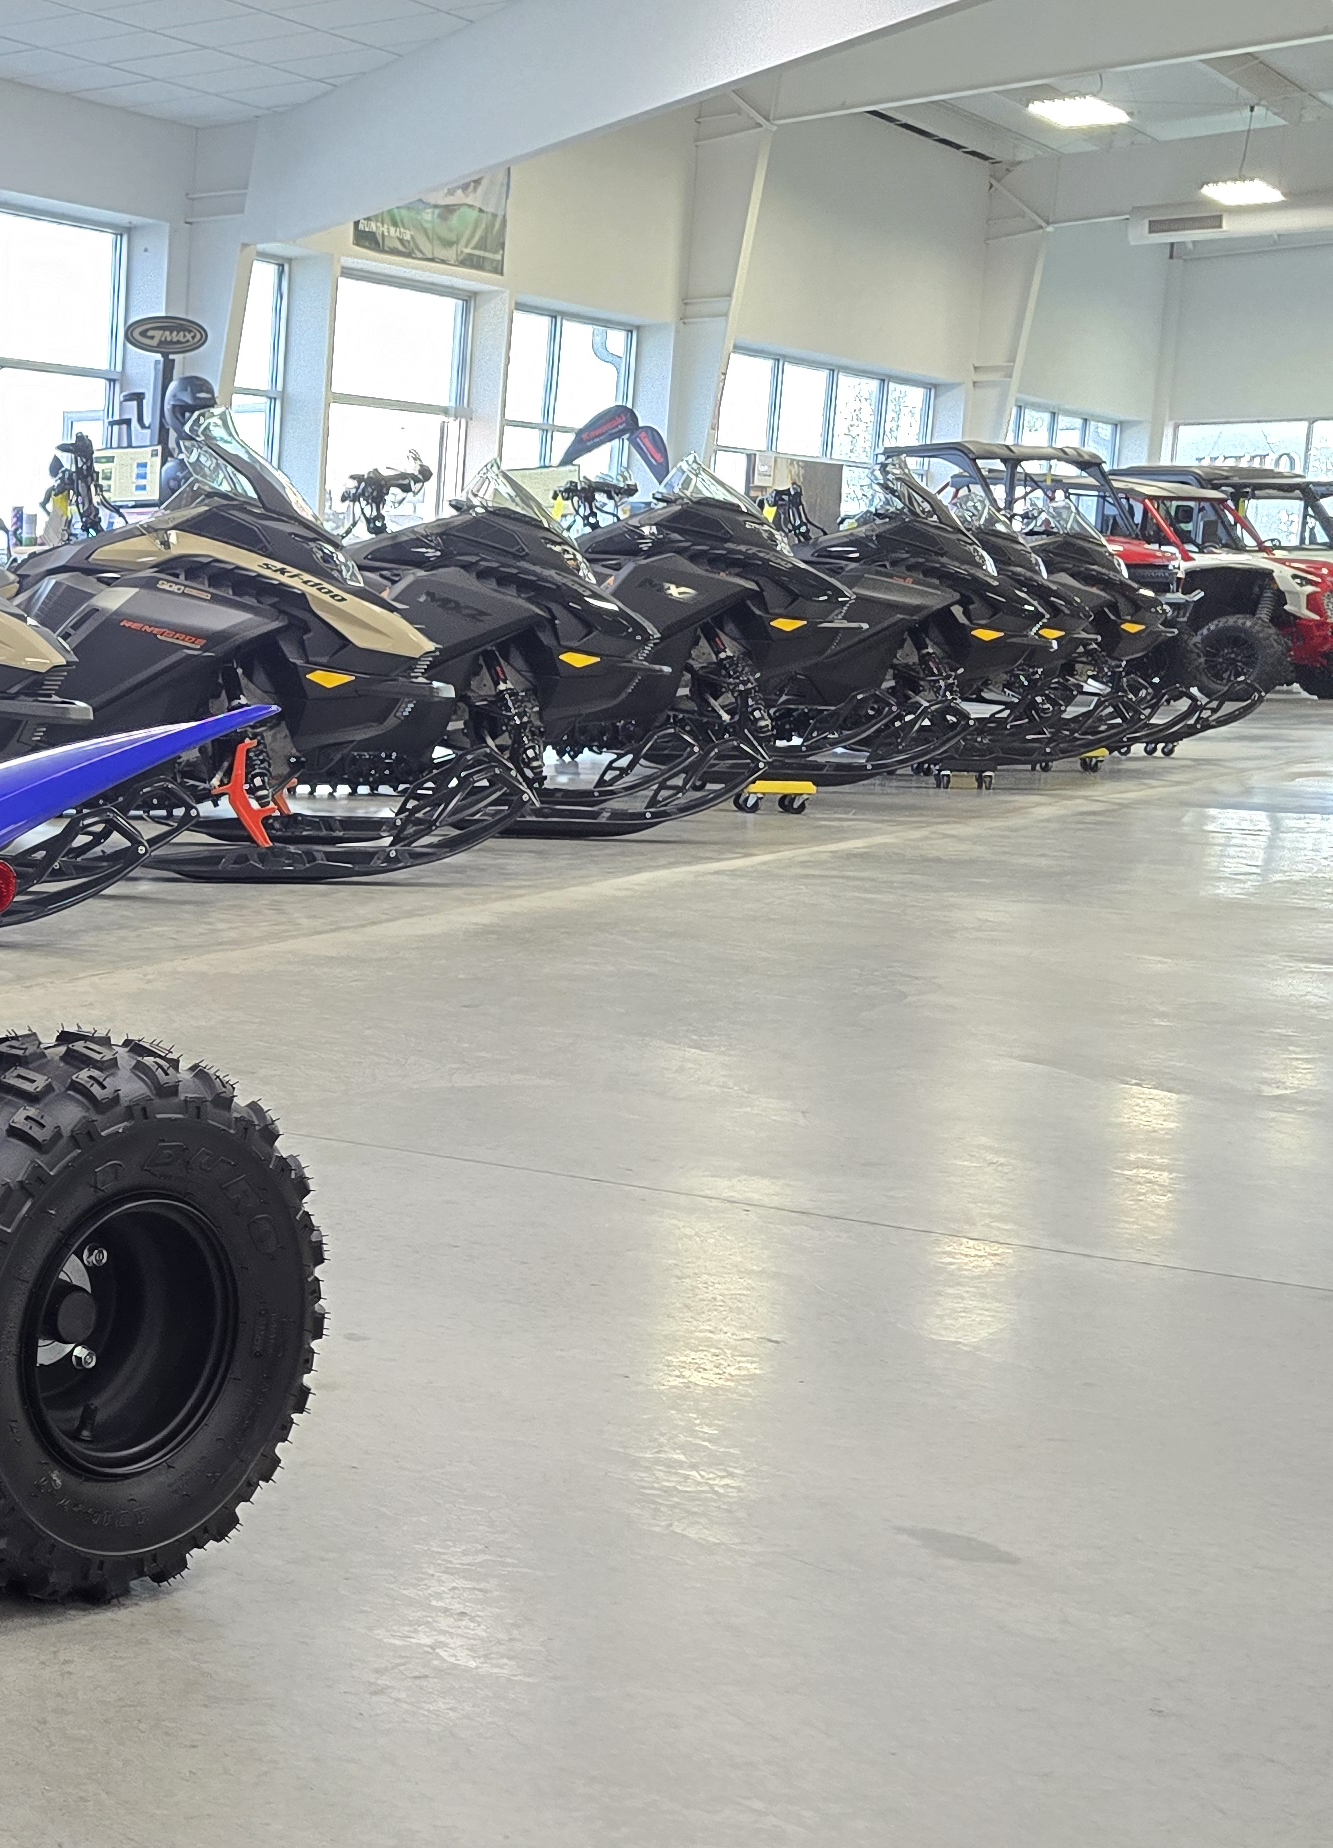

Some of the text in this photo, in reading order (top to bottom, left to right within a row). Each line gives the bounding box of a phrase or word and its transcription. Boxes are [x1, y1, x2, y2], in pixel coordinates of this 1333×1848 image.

[358, 219, 376, 232] RUN
[132, 322, 197, 347] GMAX
[156, 579, 184, 594] 900
[257, 560, 348, 604] ski-doo
[119, 619, 207, 646] RENEGADE
